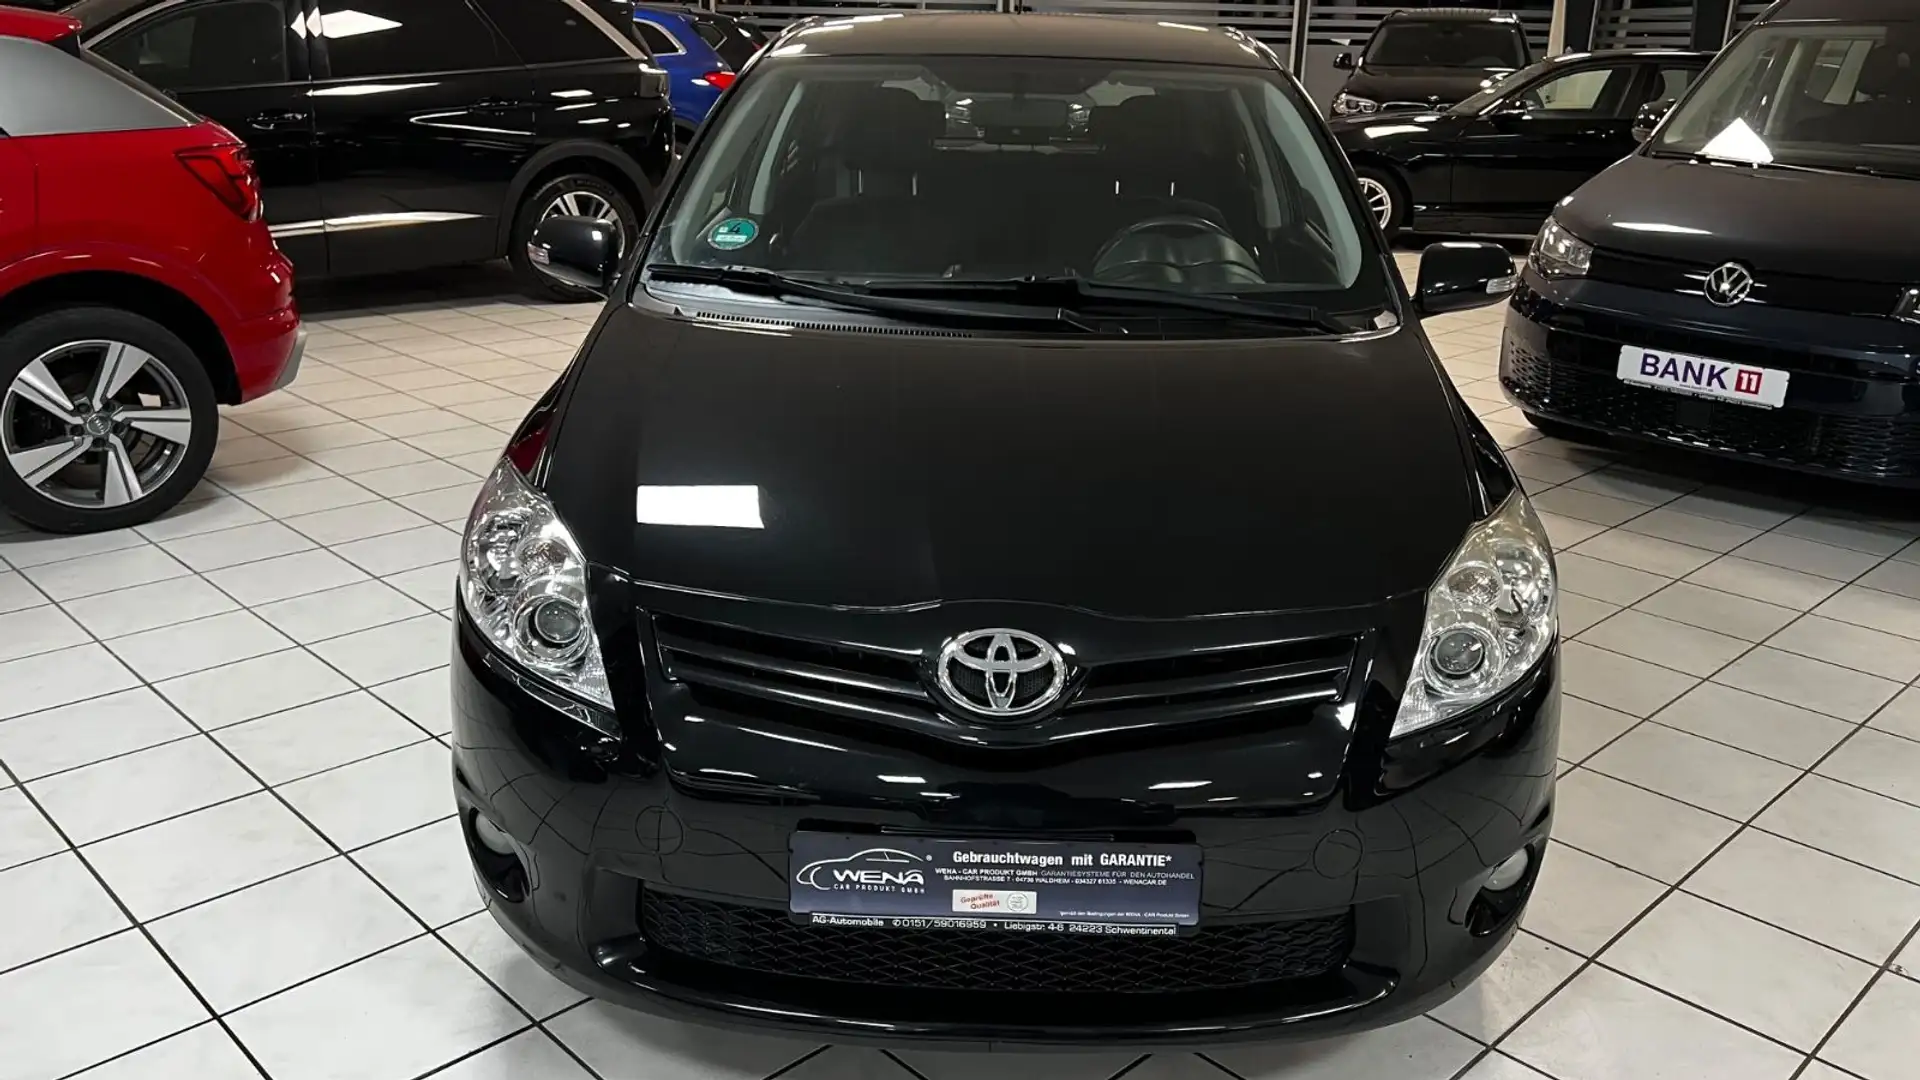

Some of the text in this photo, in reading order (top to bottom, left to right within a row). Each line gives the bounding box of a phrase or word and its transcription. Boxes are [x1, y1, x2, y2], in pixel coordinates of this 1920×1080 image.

[728, 222, 742, 234] 4
[1640, 352, 1758, 392] BANK 11
[952, 851, 1064, 868] Gebrauchtwagen
[1071, 854, 1094, 866] mit
[832, 868, 925, 885] WENA
[1040, 870, 1110, 878] GARANTIESYSTEME
[1111, 870, 1127, 878] FÜR
[1130, 871, 1146, 879] DEN
[1146, 872, 1195, 880] AUTOHANDEL
[833, 883, 850, 891] CAR
[855, 884, 896, 893] PRODUKT
[812, 915, 885, 927] AG-Automobile
[1003, 921, 1046, 932] Liebigstr.
[1047, 924, 1065, 932] 4-6
[1068, 925, 1103, 934] 24223
[1104, 926, 1177, 936] Schwentinental
